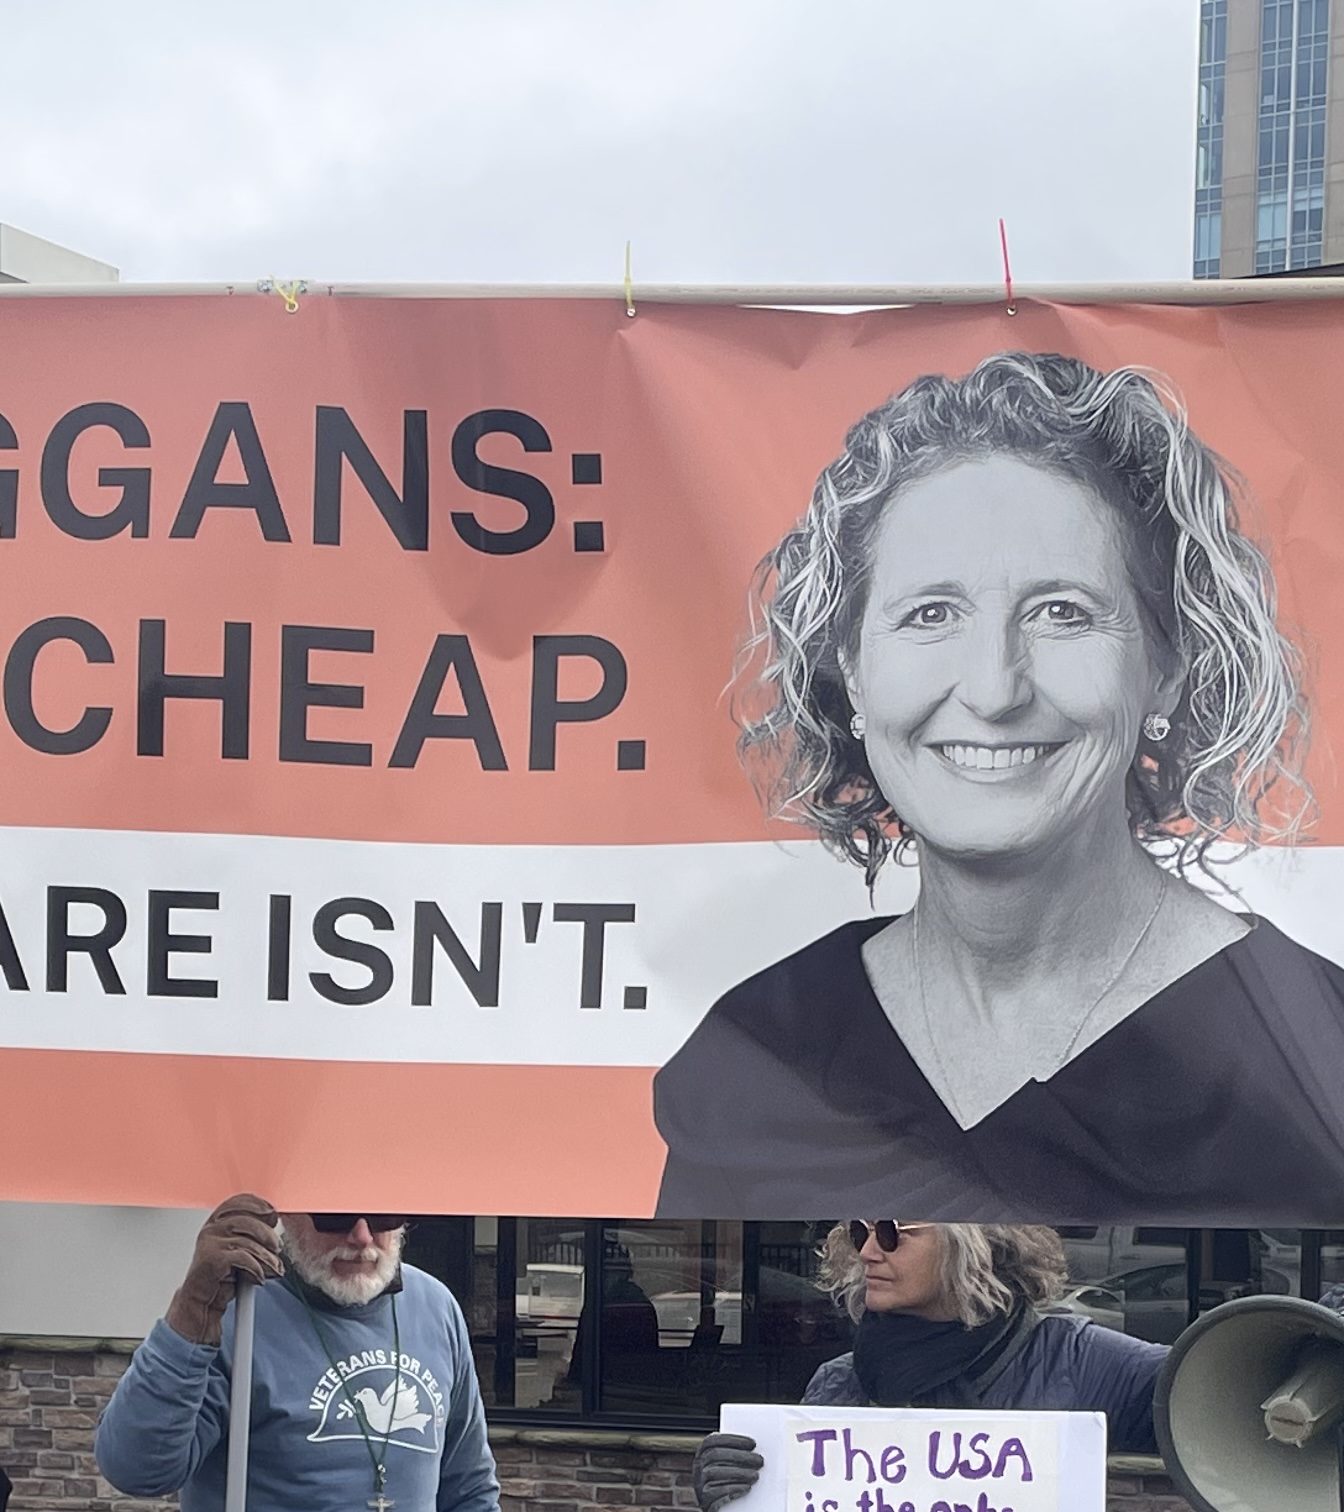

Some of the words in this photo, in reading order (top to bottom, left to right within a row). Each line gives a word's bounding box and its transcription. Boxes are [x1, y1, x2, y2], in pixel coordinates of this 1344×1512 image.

[3, 615, 647, 772] CHEAP.
[266, 893, 648, 1011] ISN'T.
[309, 1349, 387, 1410] VETERANS
[390, 1351, 421, 1374] FOR
[421, 1368, 445, 1428] PEACE
[796, 1427, 907, 1484] The
[927, 1430, 1034, 1482] USA
